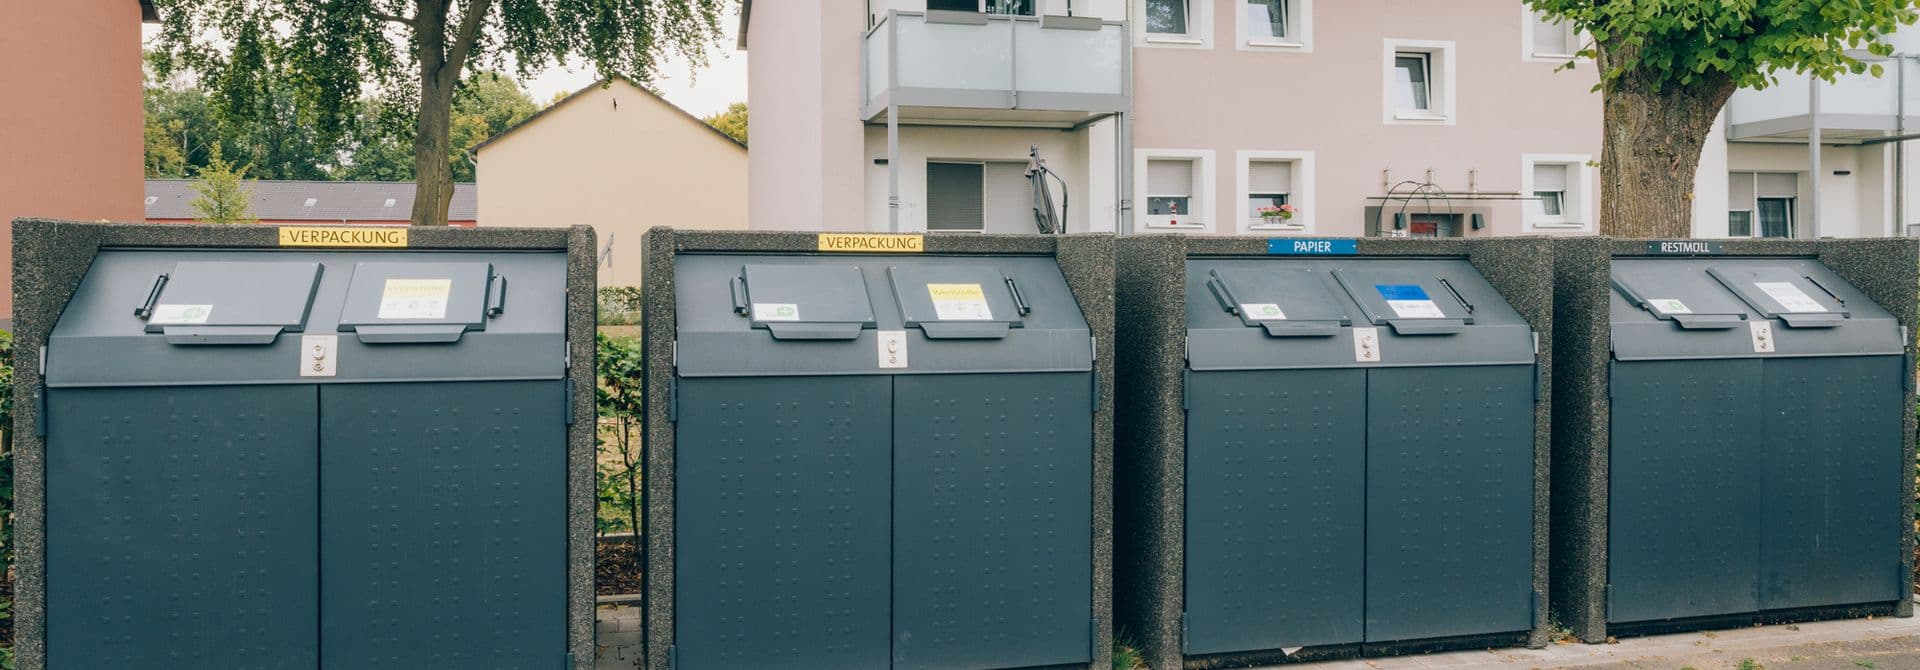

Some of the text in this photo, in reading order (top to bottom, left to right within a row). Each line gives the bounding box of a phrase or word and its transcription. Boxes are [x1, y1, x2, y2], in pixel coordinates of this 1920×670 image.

[289, 230, 399, 243] VERPACKUNG
[827, 236, 916, 248] VERPACKUNG
[1294, 241, 1331, 252] PAPIER
